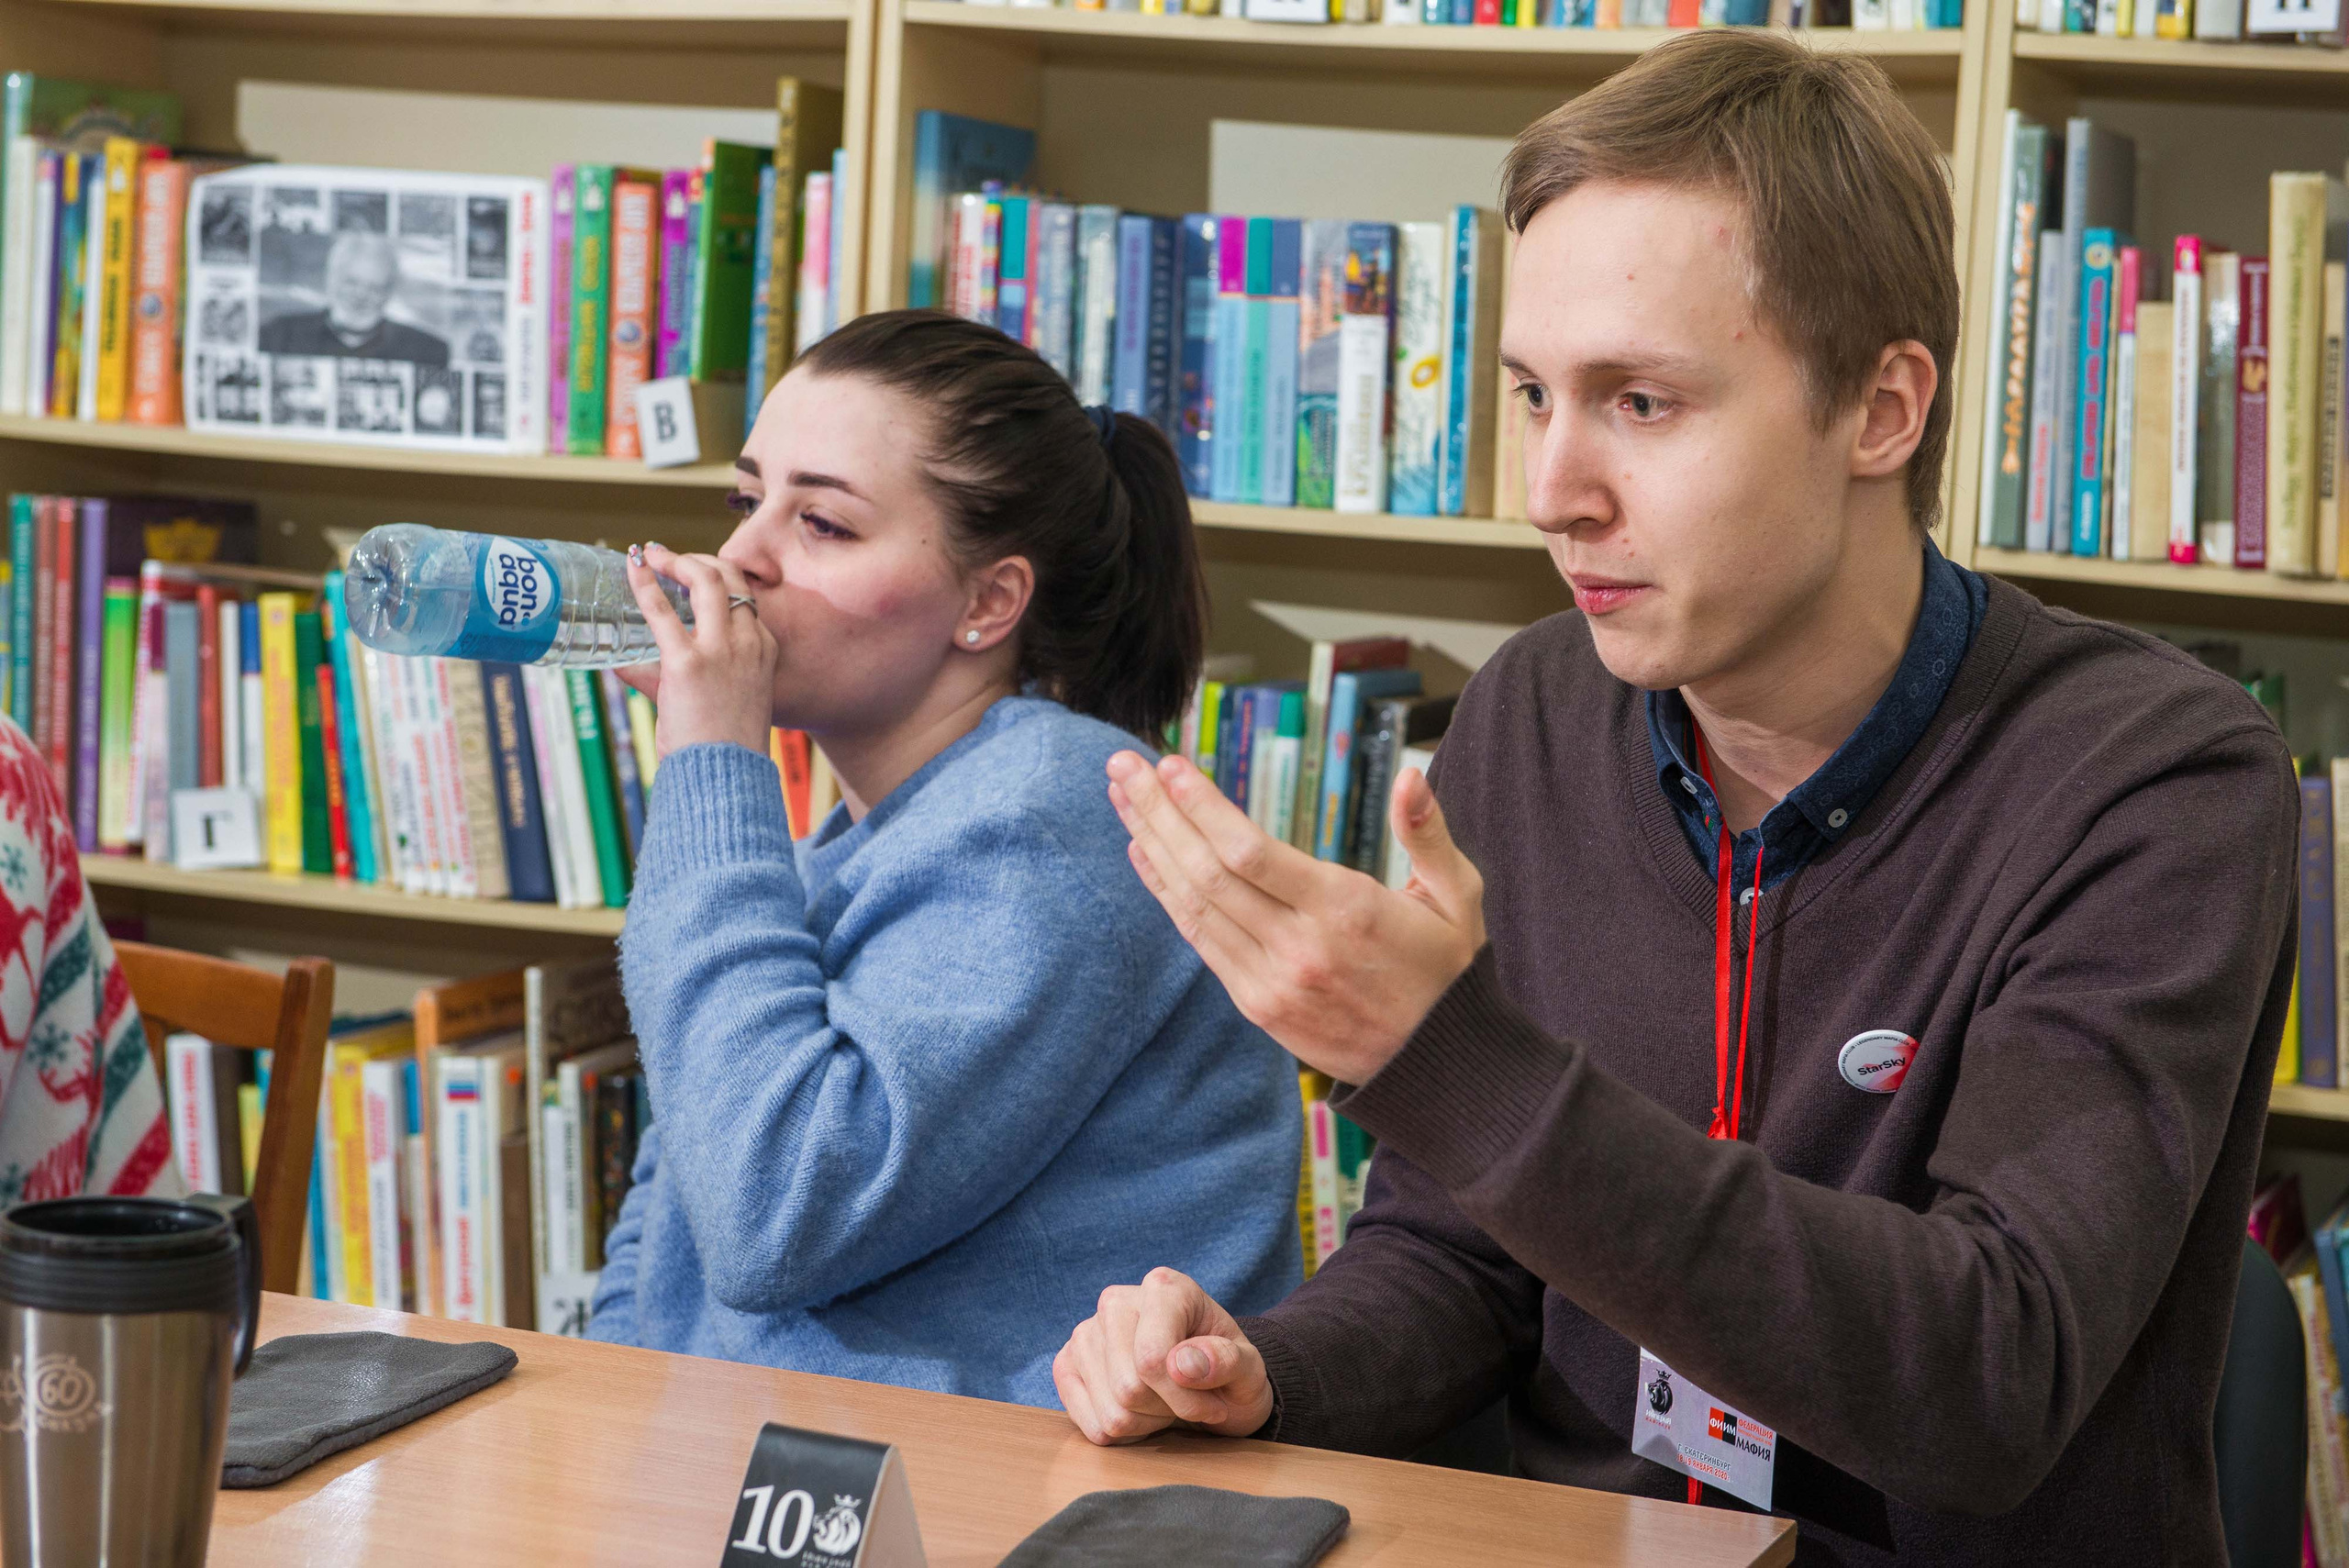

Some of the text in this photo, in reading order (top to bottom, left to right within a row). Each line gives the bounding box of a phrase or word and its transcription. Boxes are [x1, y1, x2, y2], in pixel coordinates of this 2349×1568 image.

[498, 553, 519, 625] aqua
[1857, 1057, 1907, 1076] StarSky
[1709, 1418, 1736, 1436] ФИИМ
[1738, 1418, 1774, 1440] ФЕДЕРАЦИЯ
[1685, 1446, 1731, 1470] ЕКАТЕРИНБУРГ
[1736, 1437, 1771, 1462] МАФИЯ
[1692, 1460, 1713, 1474] ЯНВАРЯ
[731, 1485, 815, 1559] 10
